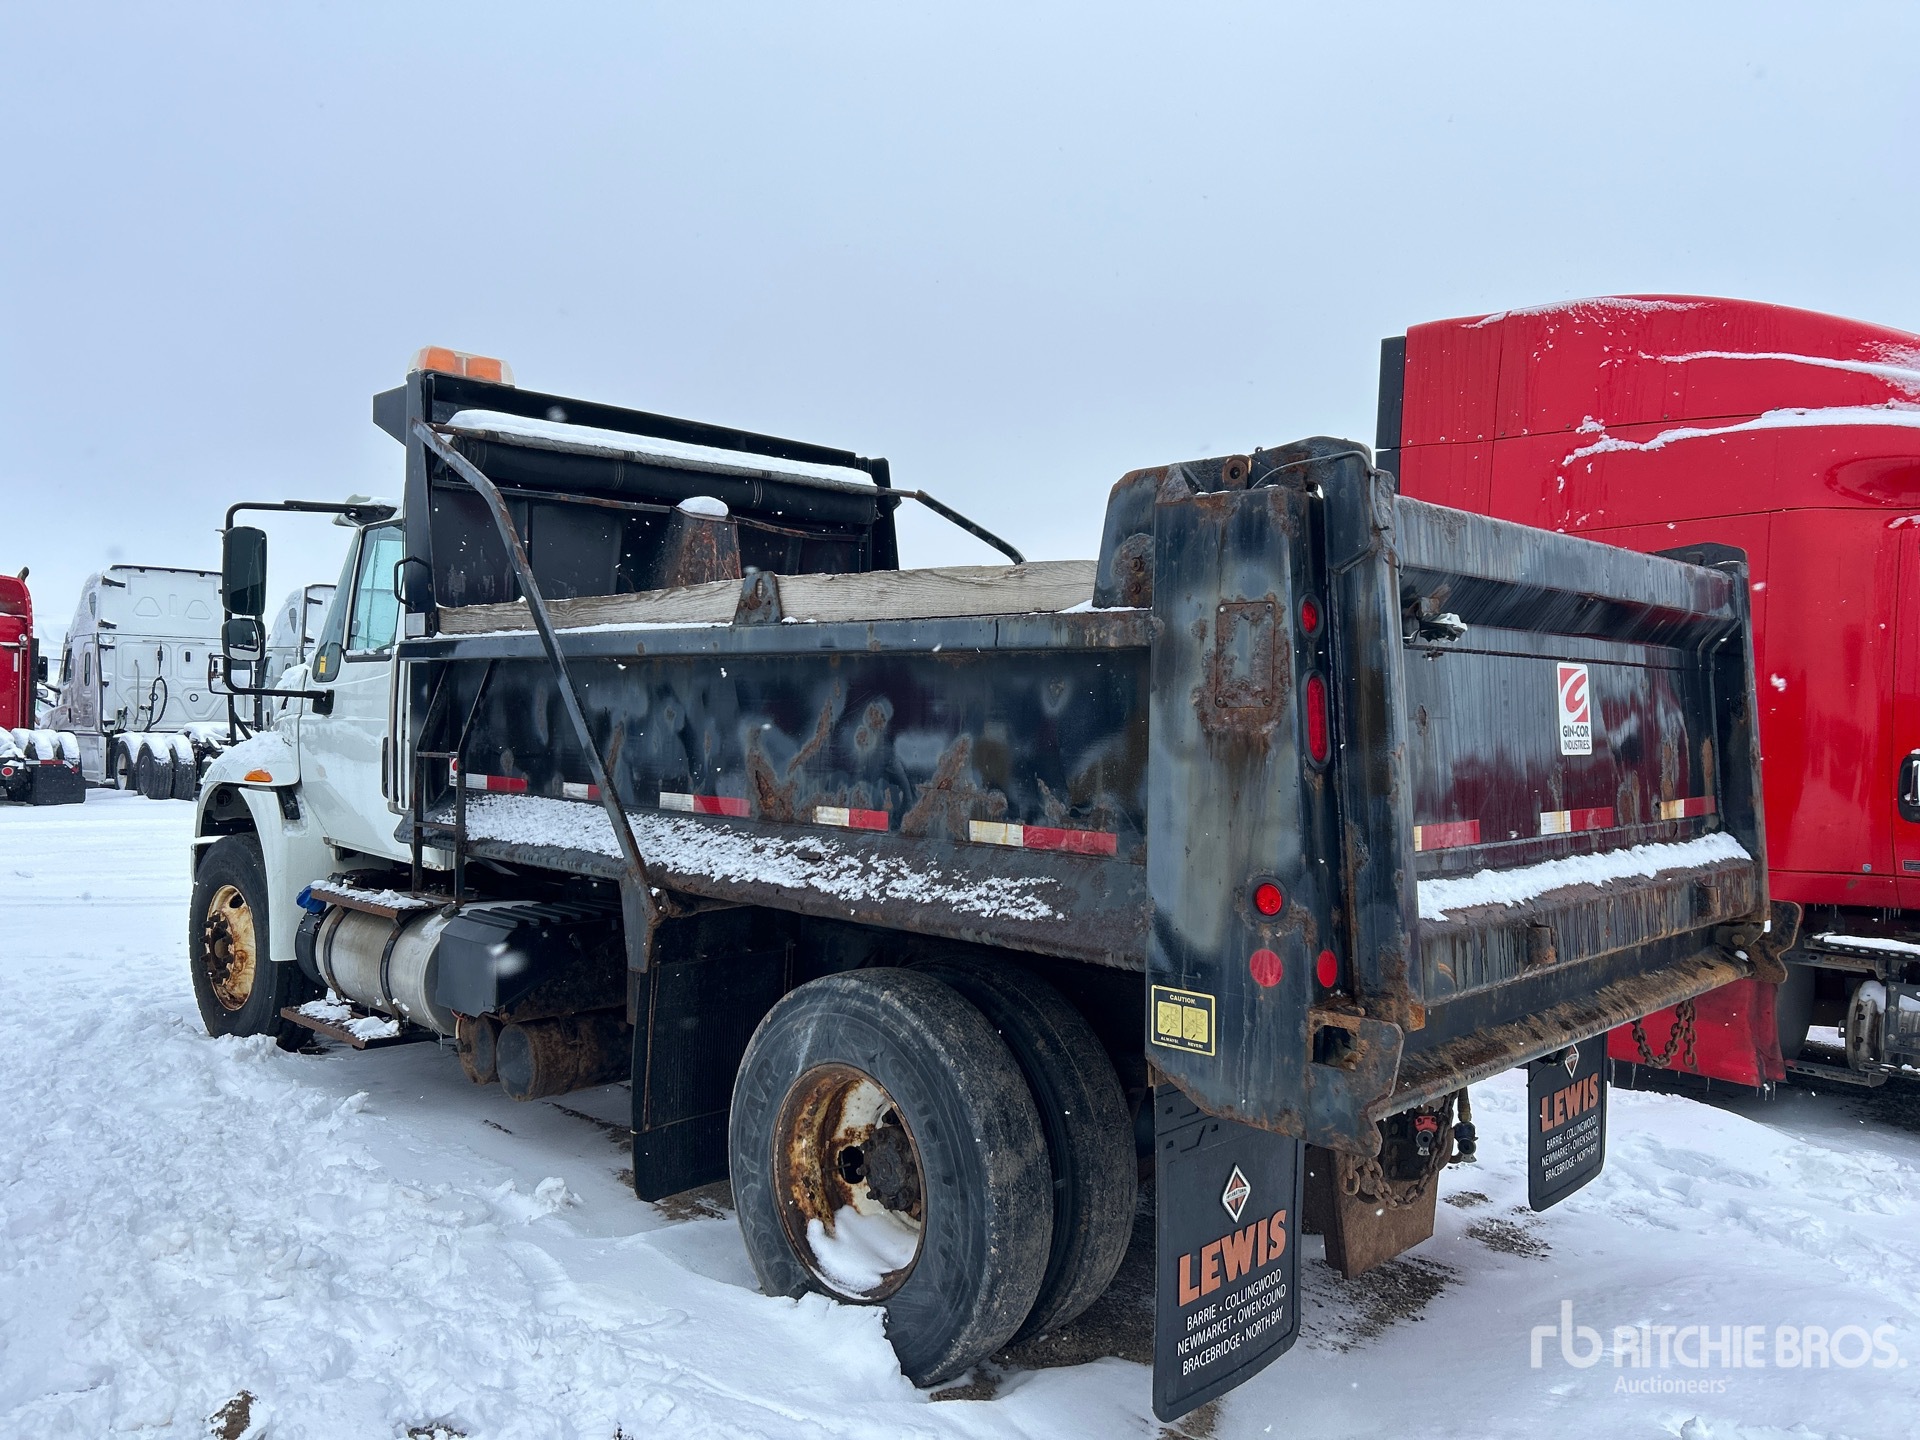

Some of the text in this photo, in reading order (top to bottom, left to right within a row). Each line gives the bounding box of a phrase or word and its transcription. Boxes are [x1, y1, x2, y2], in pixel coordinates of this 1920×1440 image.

[1563, 725, 1589, 737] GIN-COR
[1541, 1072, 1599, 1133] LEWIS
[1546, 1114, 1597, 1151] BARRIE COLLINGWOOD
[1541, 1142, 1570, 1167] NEWMARKET
[1545, 1155, 1575, 1182] BRACEBRIDGE
[1179, 1209, 1287, 1308] LEWIS
[1177, 1283, 1287, 1357] NEWMARKET OWEN SOUND
[1187, 1268, 1282, 1331] BARRIE COLLINGWOOD
[1182, 1305, 1284, 1376] BRACEBRIDGE NORTH BAY
